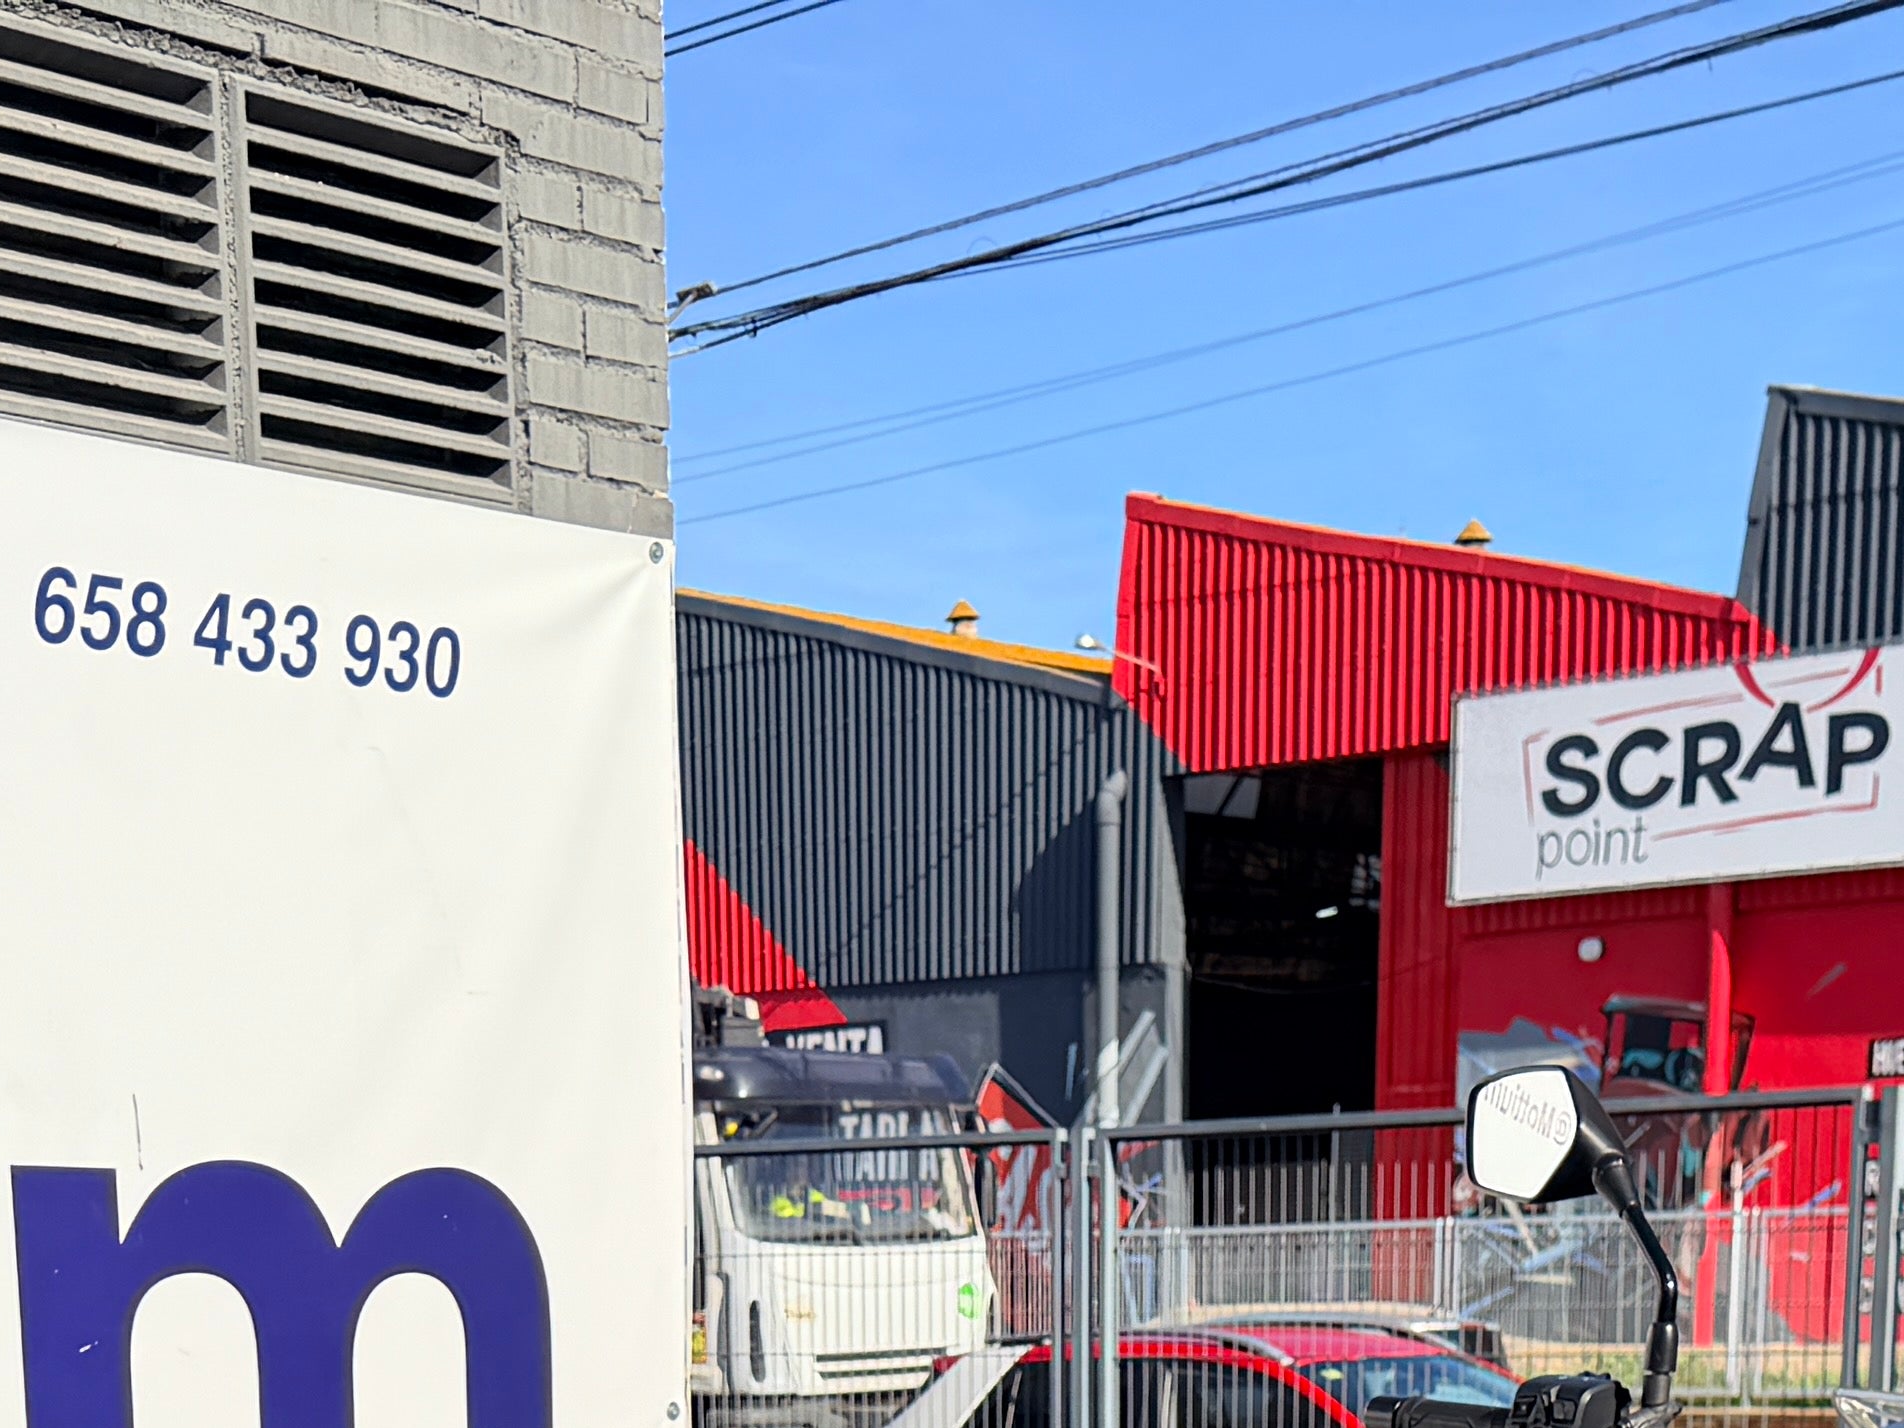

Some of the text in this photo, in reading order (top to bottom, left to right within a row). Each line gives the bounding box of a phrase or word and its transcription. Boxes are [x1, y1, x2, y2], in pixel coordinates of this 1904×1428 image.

[34, 567, 461, 699] 658 433 930
[1541, 702, 1889, 817] SCRAP
[1536, 815, 1651, 882] point
